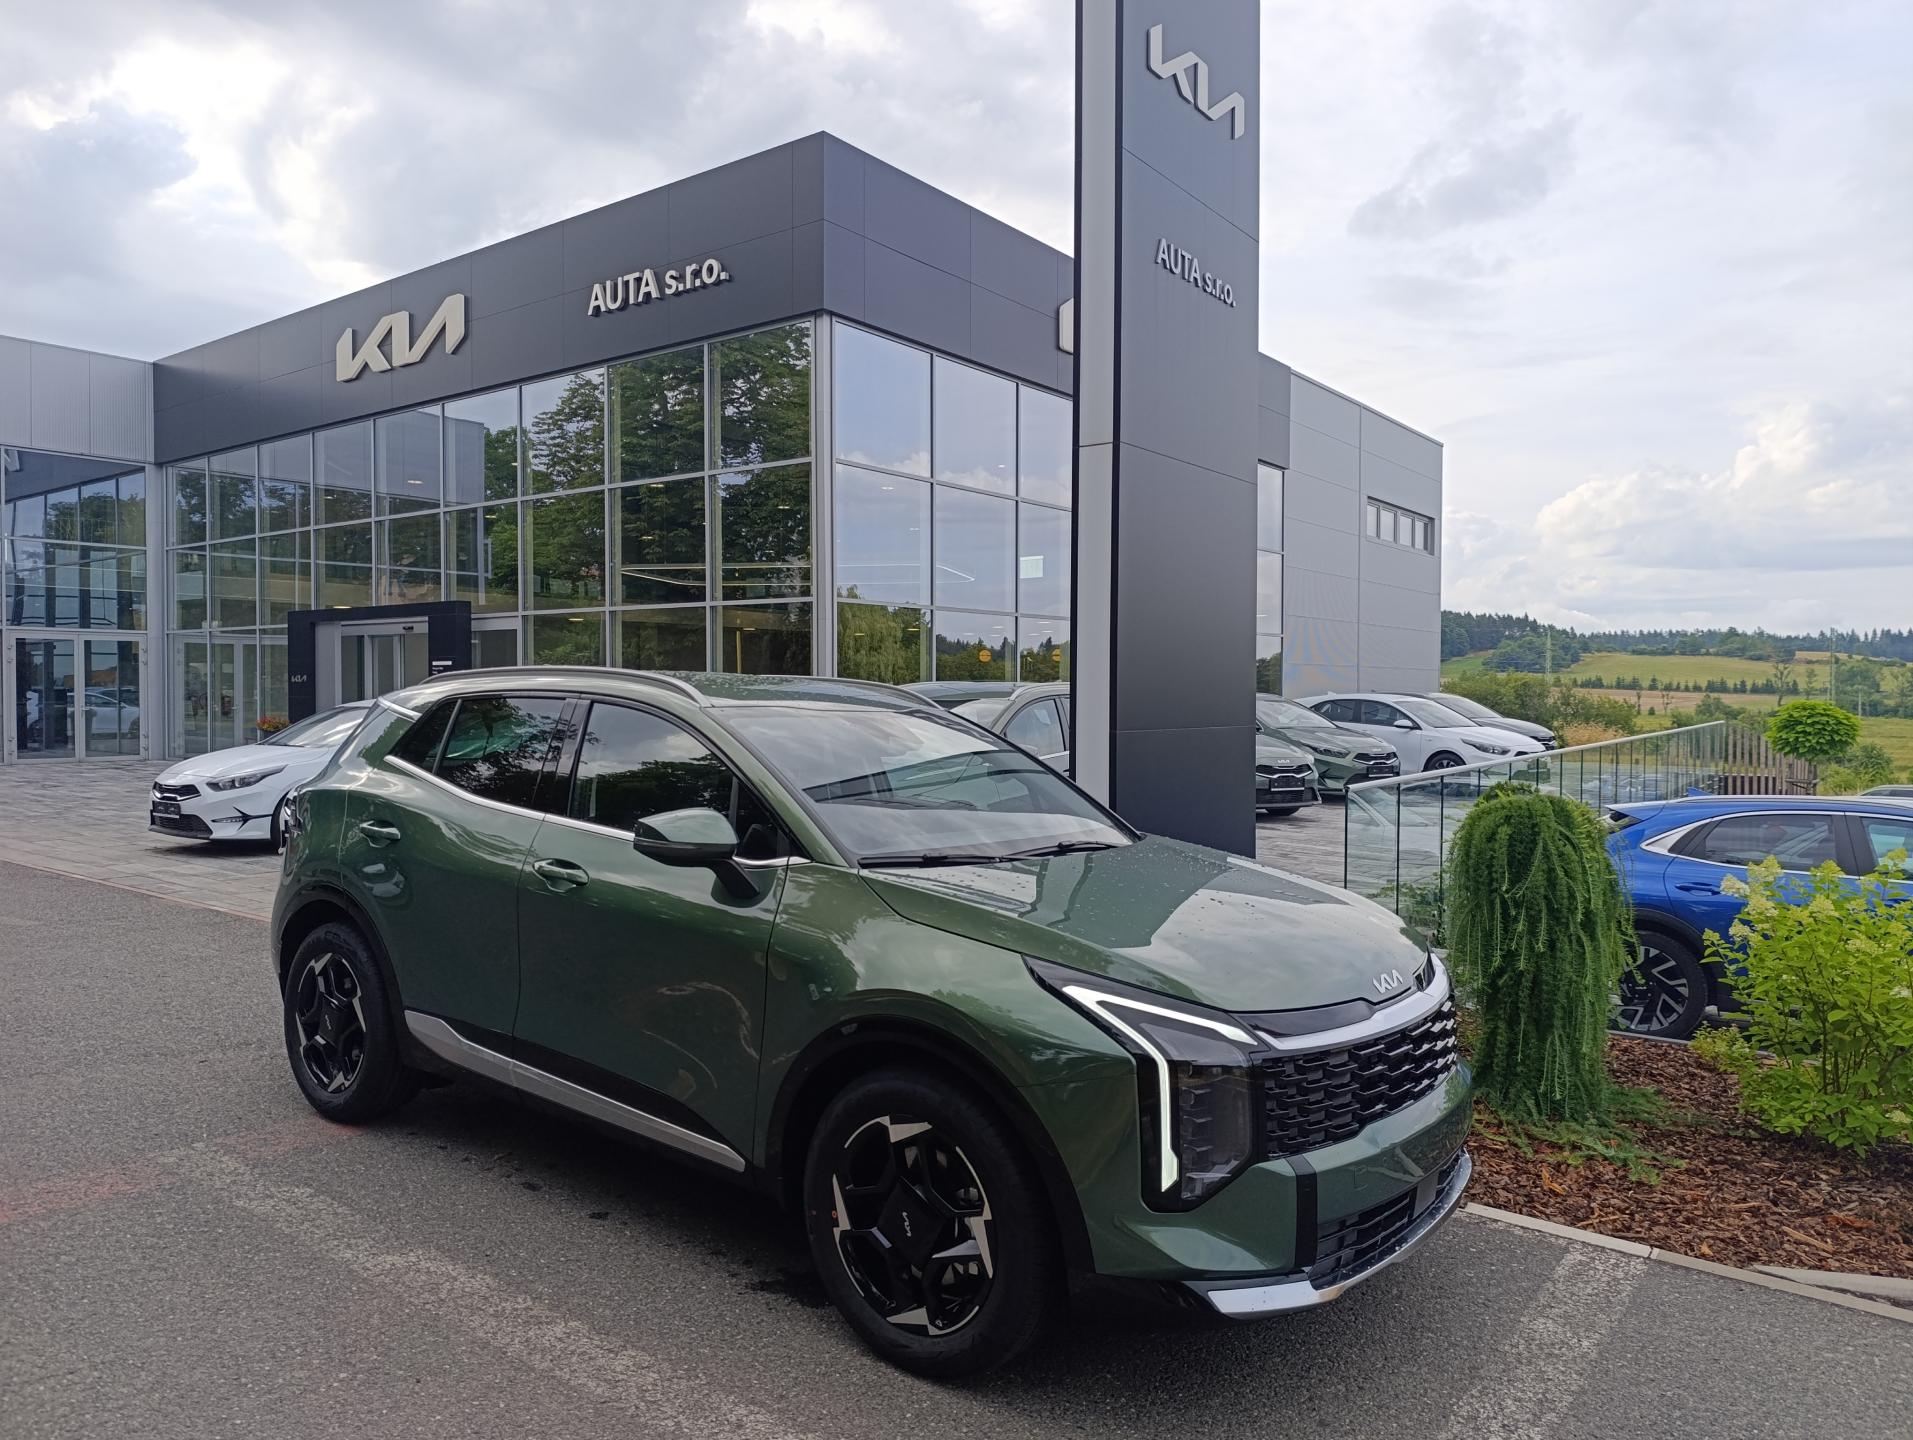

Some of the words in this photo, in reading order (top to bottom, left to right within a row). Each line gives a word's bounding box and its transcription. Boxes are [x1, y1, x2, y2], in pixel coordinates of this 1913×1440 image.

[1147, 23, 1245, 140] KIA
[588, 268, 661, 316] AUTA
[665, 258, 730, 296] s.r.o.
[1156, 238, 1201, 288] AUTA
[1203, 272, 1236, 307] s.r.o.
[336, 293, 466, 382] KIA
[1372, 969, 1403, 994] KIA
